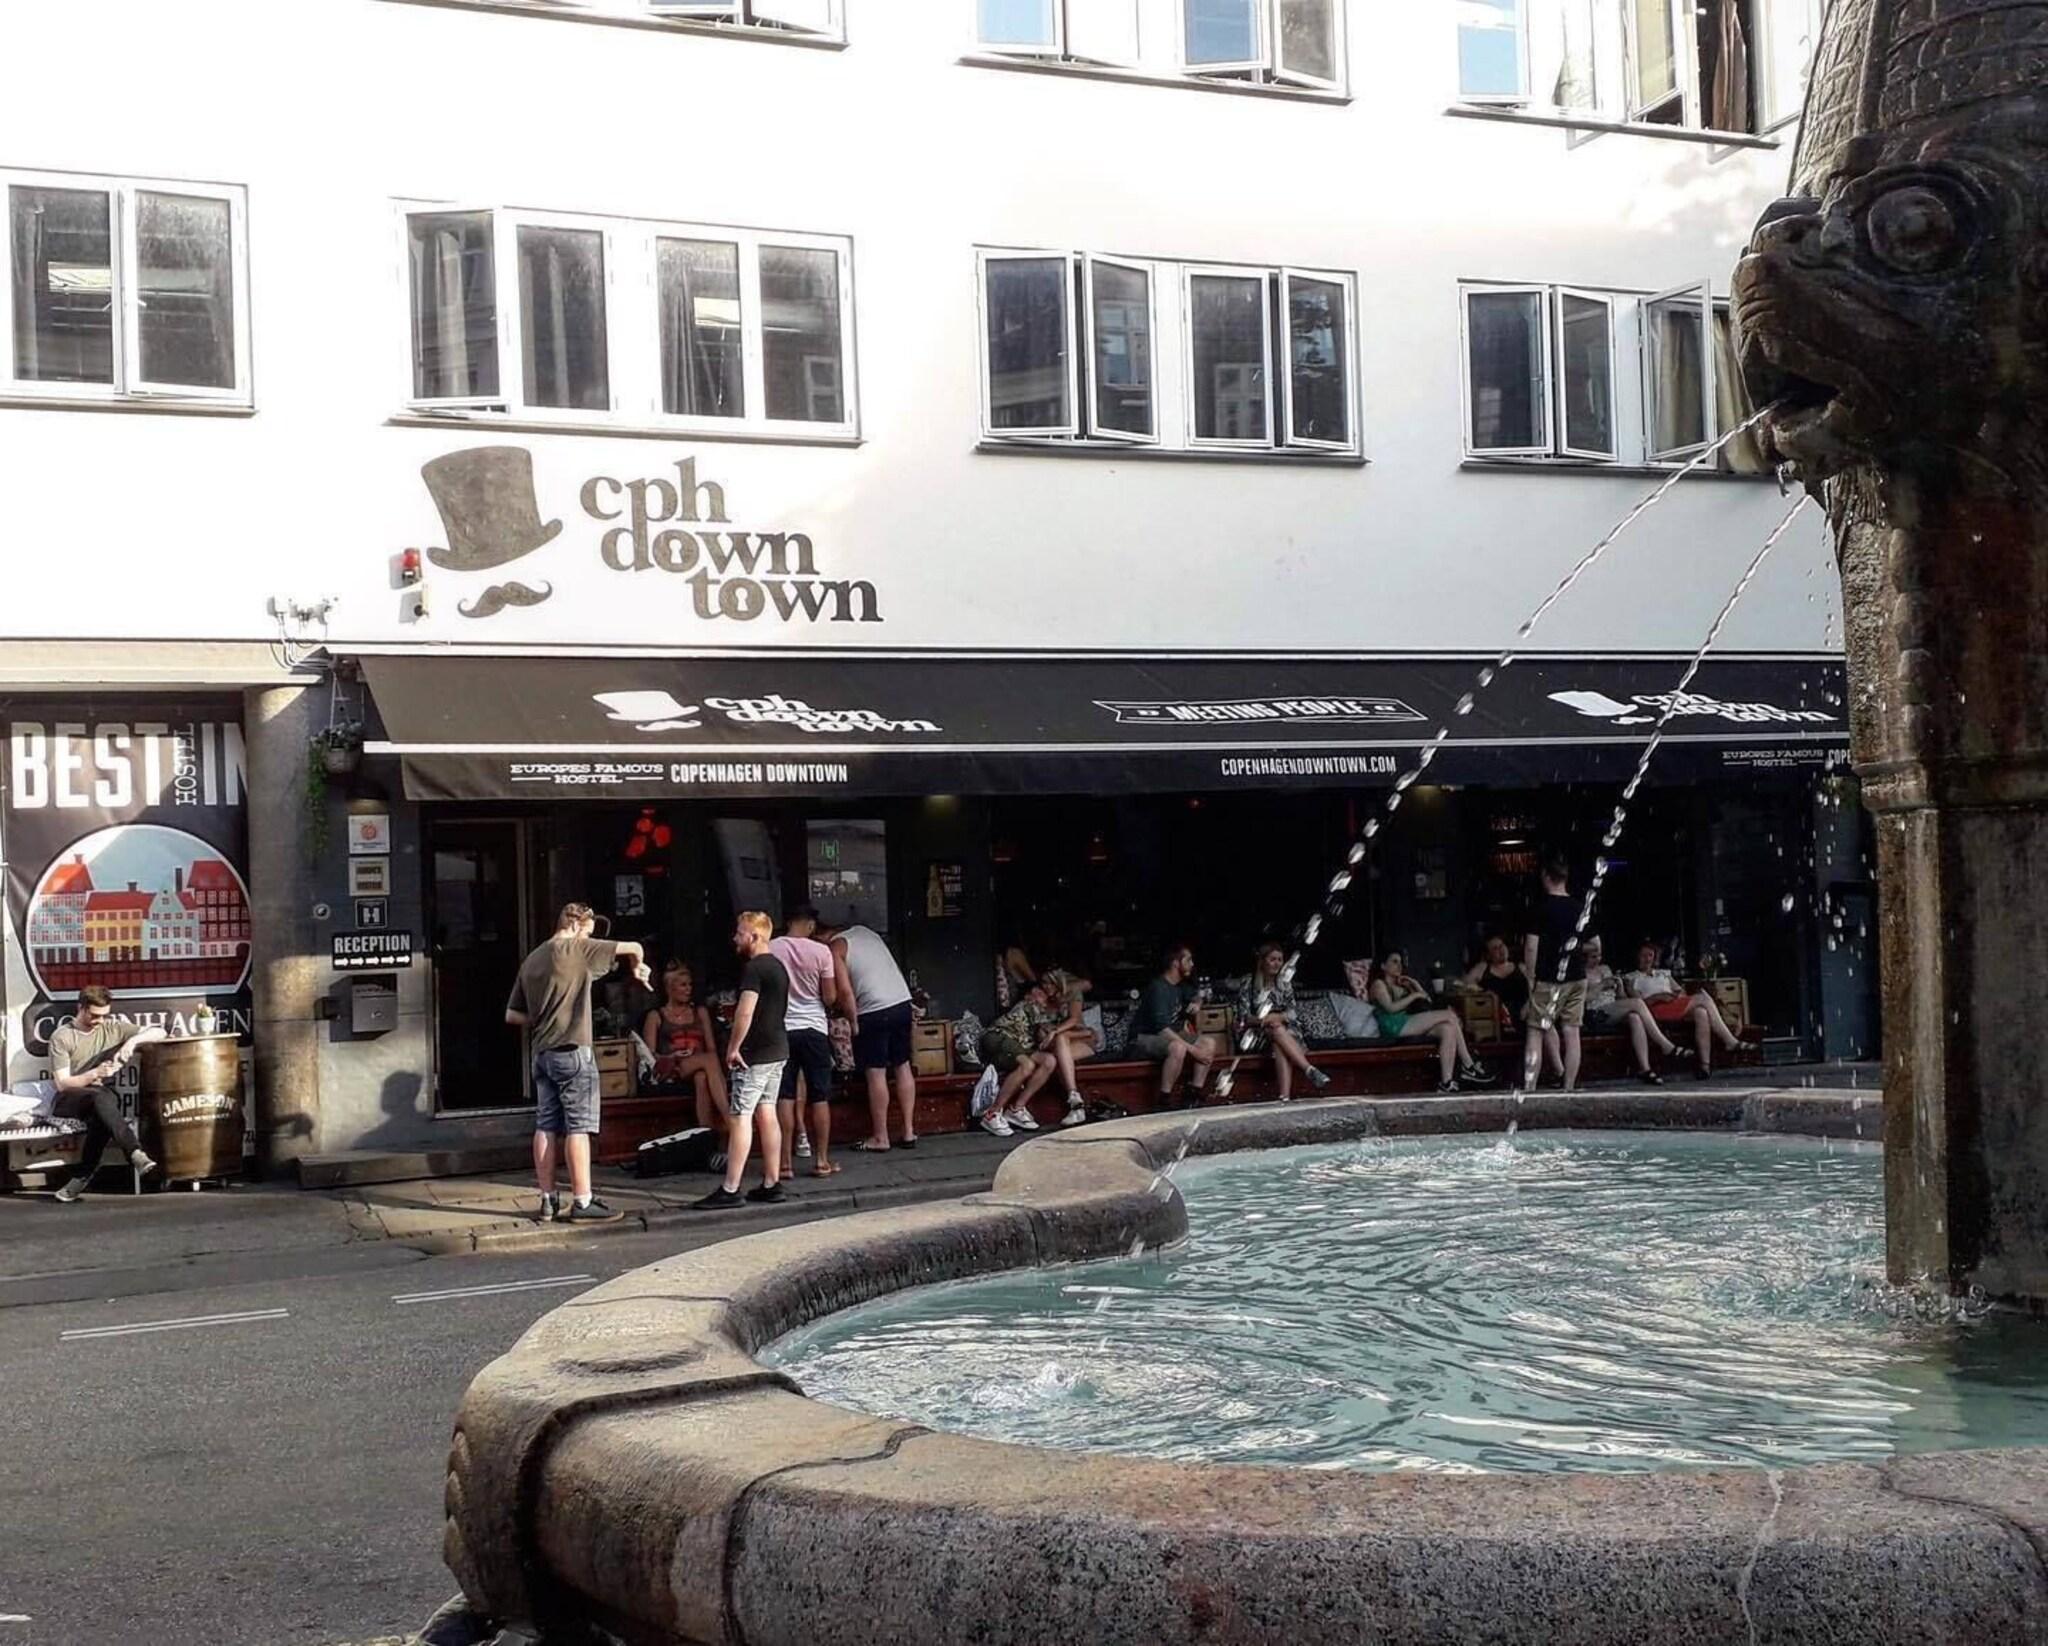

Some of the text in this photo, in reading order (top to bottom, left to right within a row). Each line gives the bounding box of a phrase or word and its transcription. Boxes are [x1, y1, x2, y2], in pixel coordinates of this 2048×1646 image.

[580, 456, 732, 530] cph
[600, 527, 821, 576] down
[685, 566, 884, 623] town
[704, 694, 815, 712] cph
[1165, 700, 1370, 720] MEETING PEOPLE
[726, 709, 887, 722] down
[791, 720, 943, 732] town
[11, 722, 169, 809] BEST
[173, 722, 198, 806] HOSTEL
[510, 763, 664, 774] EUROPES FAMOUS
[670, 764, 848, 783] COPENHAGEN DOWNTOWN
[1221, 756, 1397, 776] COPENHAGENDOWNTOWN.COM
[554, 774, 623, 784] HOSTEL
[334, 934, 411, 954] RECEPTION
[163, 1094, 236, 1117] JAMESON
